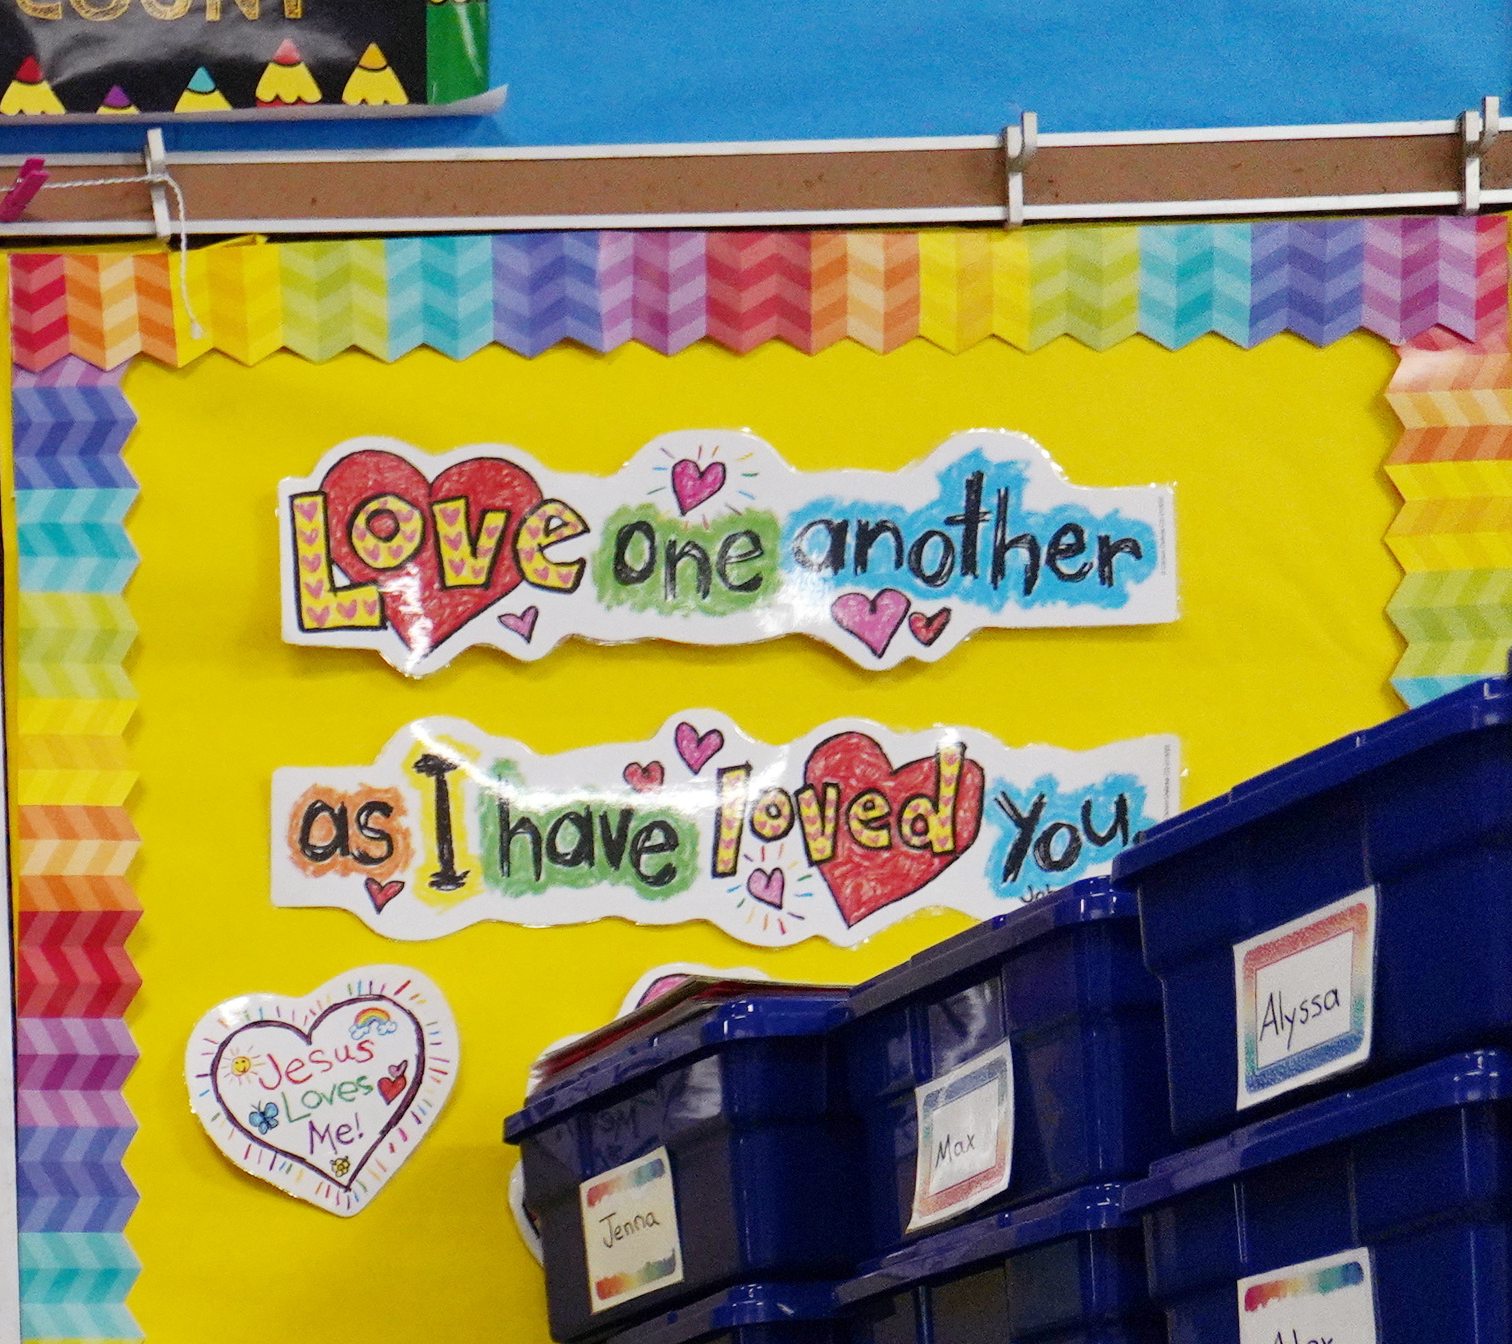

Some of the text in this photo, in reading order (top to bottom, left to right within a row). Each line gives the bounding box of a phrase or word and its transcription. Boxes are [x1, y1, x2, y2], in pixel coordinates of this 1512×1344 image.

[611, 519, 766, 601] one
[792, 469, 1145, 595] another
[298, 795, 395, 868] as
[412, 752, 469, 892] I
[494, 792, 680, 887] have
[711, 740, 969, 879] loved
[1260, 981, 1342, 1049] Alyssa
[258, 1038, 376, 1092] Jesus
[281, 1074, 374, 1124] Loves
[308, 1112, 365, 1156] Me!
[934, 1125, 977, 1169] Max
[598, 1206, 663, 1252] Jenna
